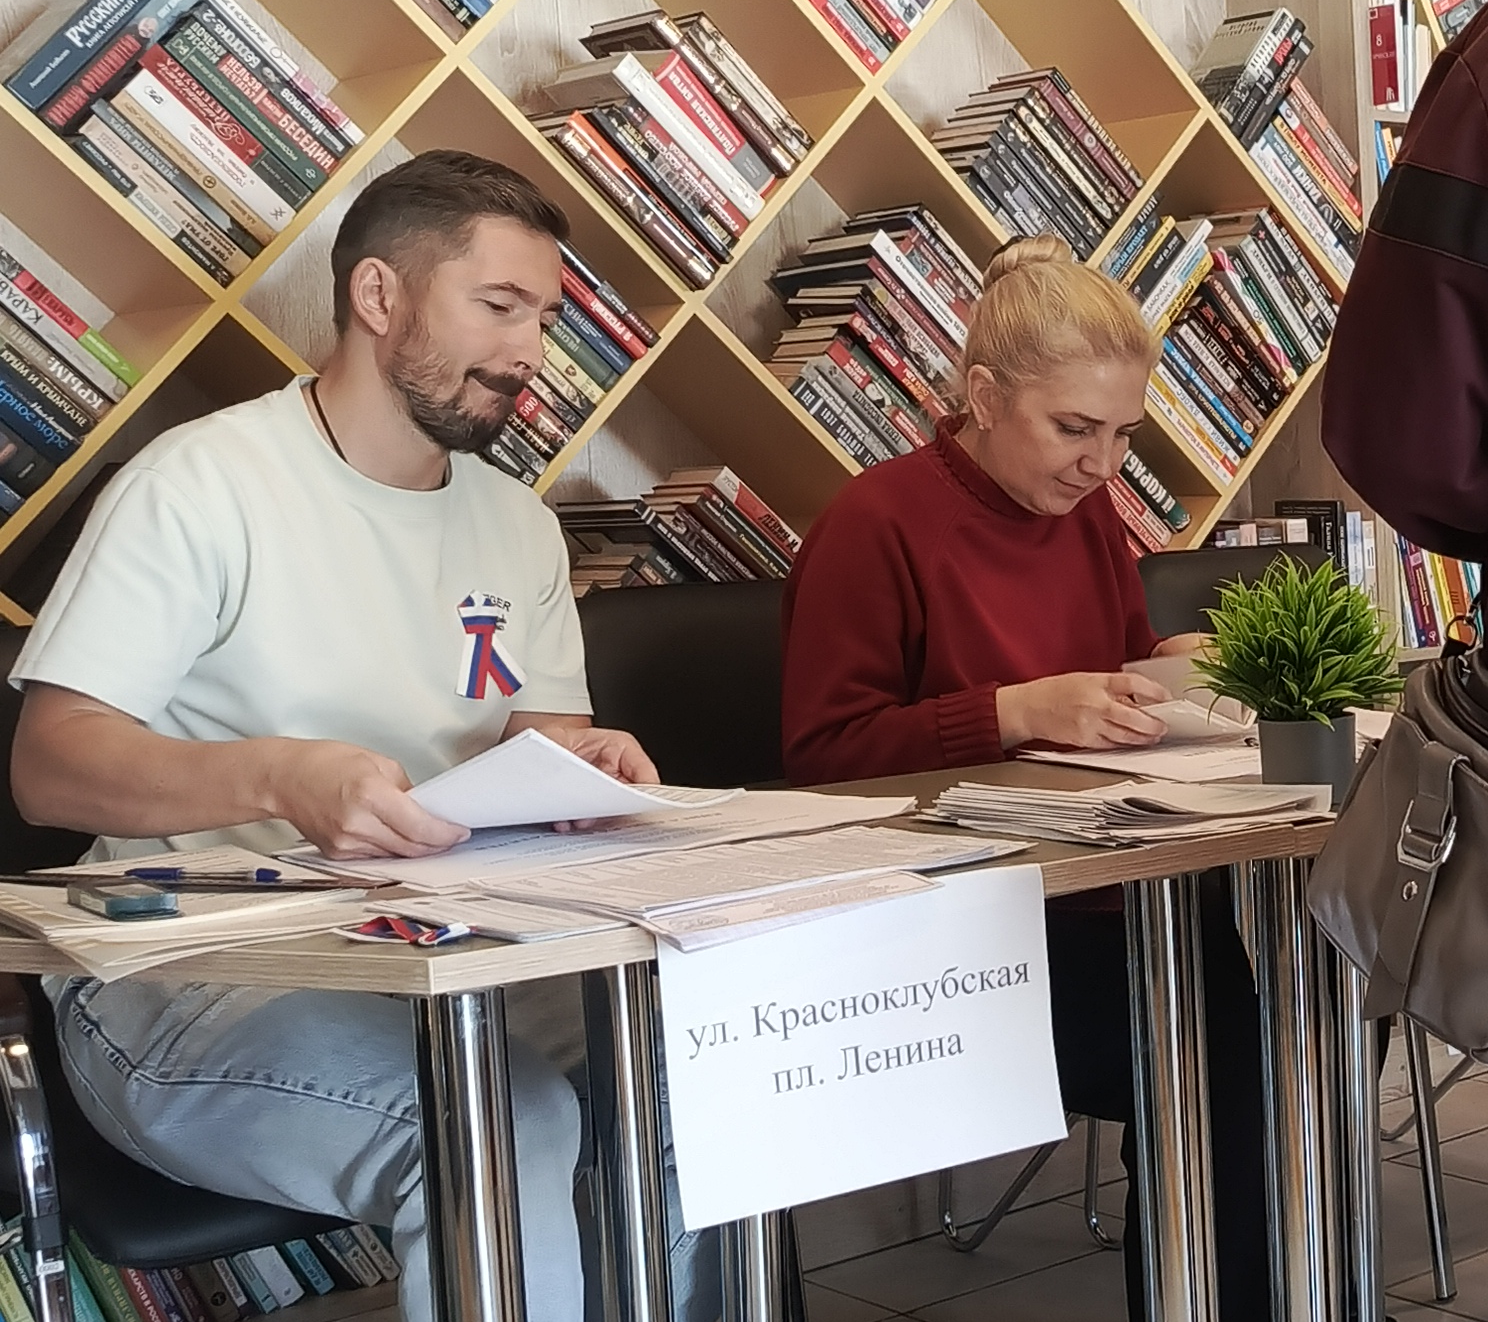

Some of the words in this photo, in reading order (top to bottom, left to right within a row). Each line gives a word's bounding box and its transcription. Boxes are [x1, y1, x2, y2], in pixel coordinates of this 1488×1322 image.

[191, 21, 228, 58] ПОЧЕМУ
[227, 56, 263, 93] НЕЛЬЗЯ
[278, 115, 335, 175] БЕСЕДИН
[200, 236, 212, 247] ОТ
[209, 243, 230, 262] ГОРЕ
[850, 388, 885, 425] INCOGNITA
[878, 420, 903, 445] TERRA
[686, 1019, 739, 1060] ул.
[751, 961, 1032, 1041] Красноклубская
[773, 1061, 825, 1095] пл.
[837, 1031, 964, 1082] Ленина
